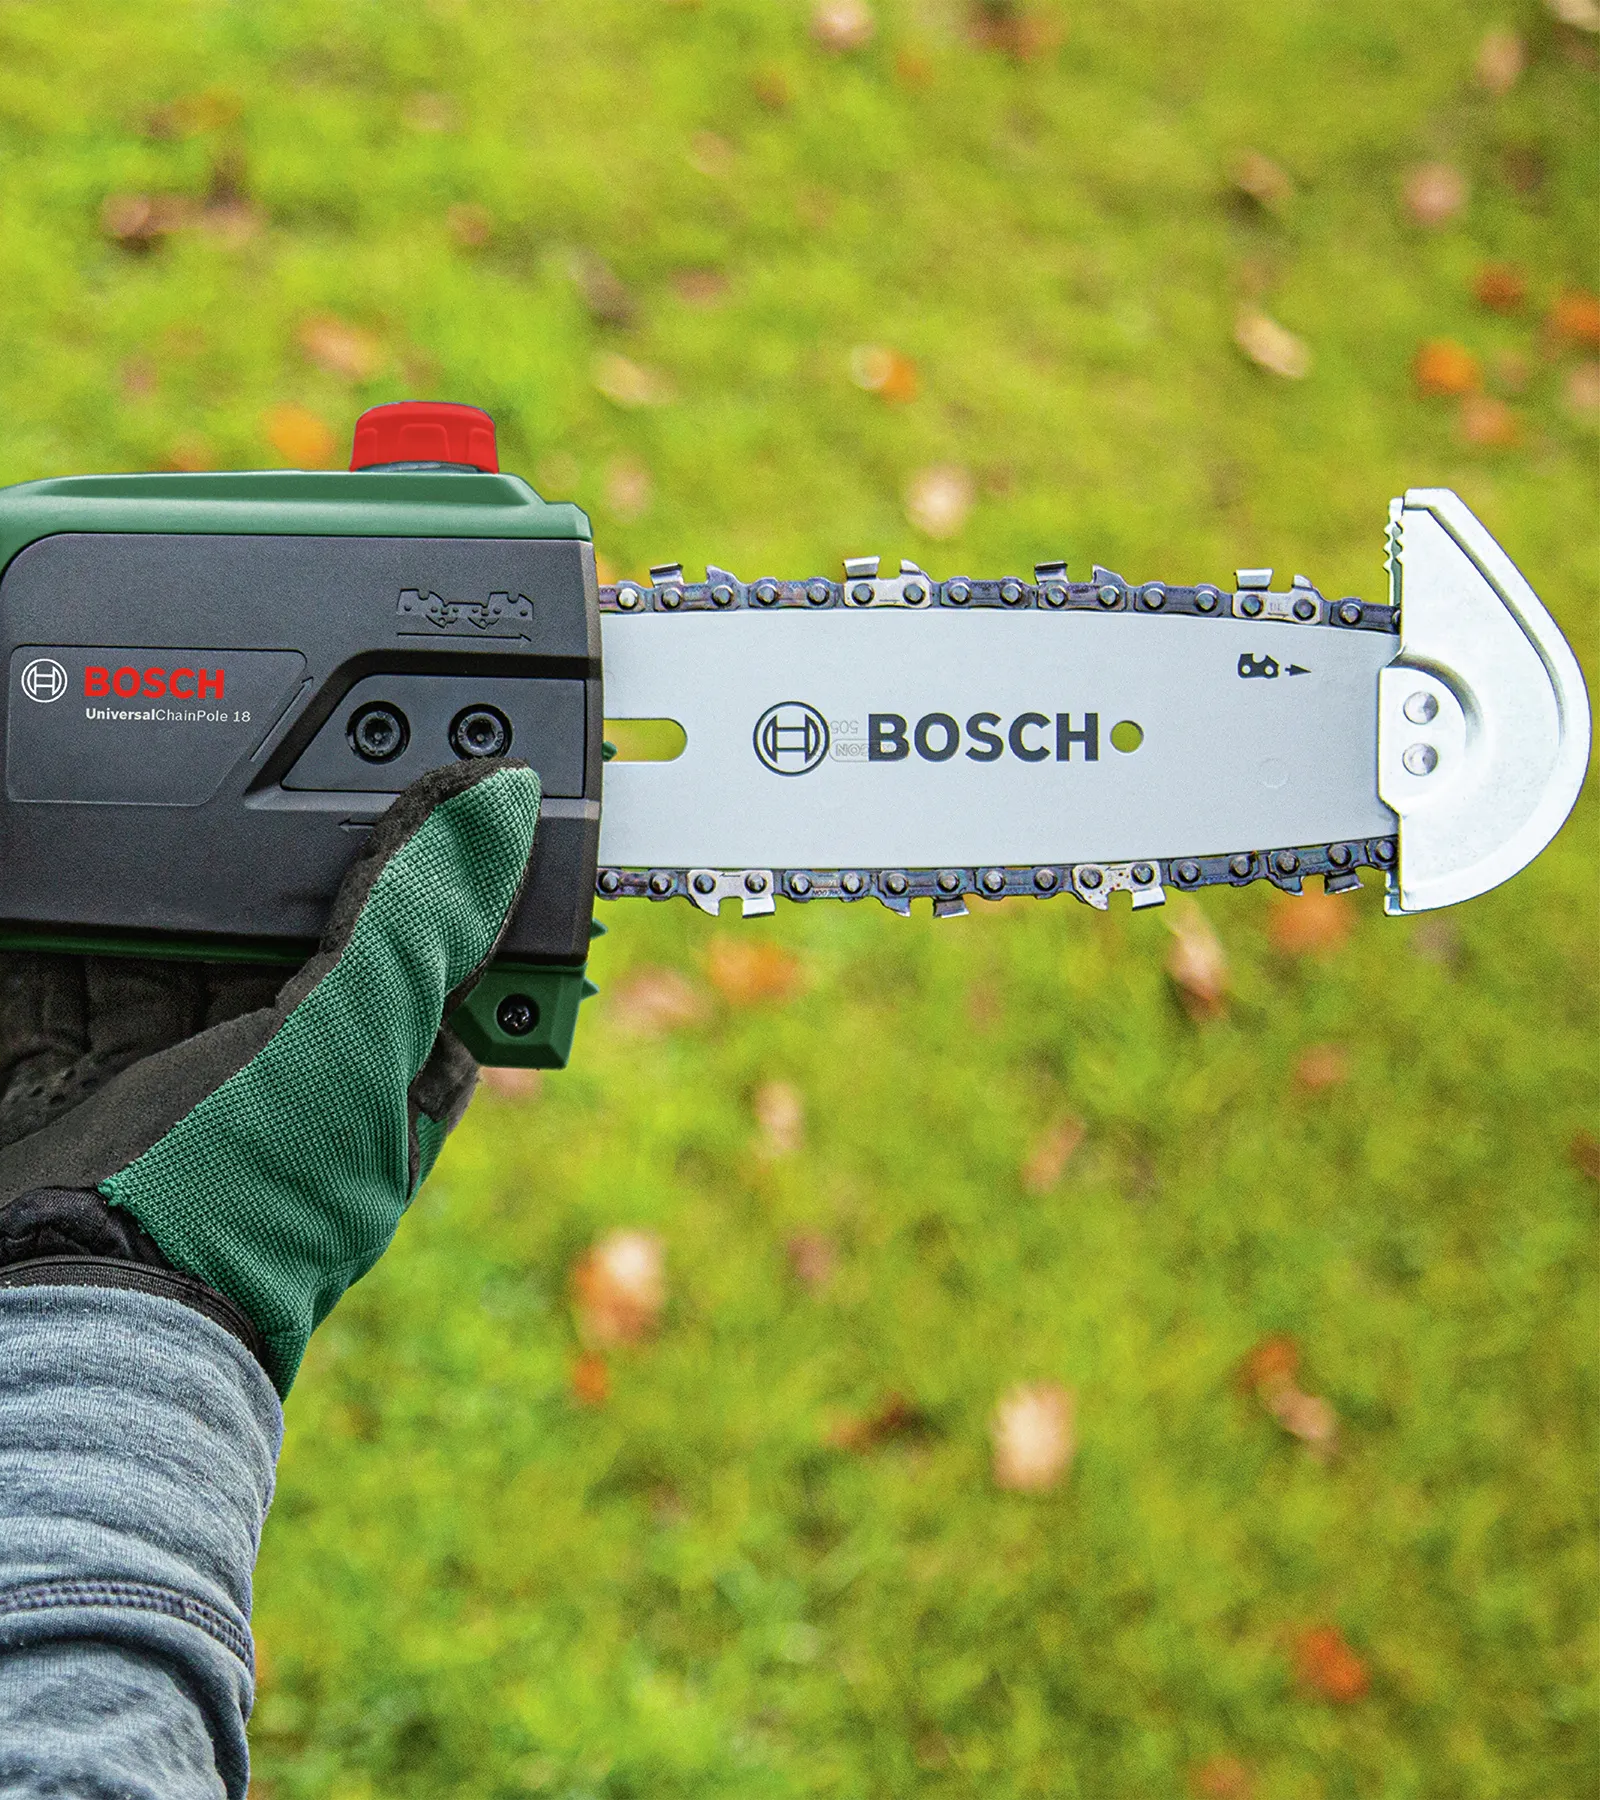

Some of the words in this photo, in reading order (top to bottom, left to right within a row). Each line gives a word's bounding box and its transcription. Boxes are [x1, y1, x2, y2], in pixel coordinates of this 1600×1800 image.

[84, 666, 225, 700] BOSCH
[85, 707, 228, 723] UniversalChainPole
[233, 710, 251, 723] 18
[868, 712, 1099, 762] BOSCH
